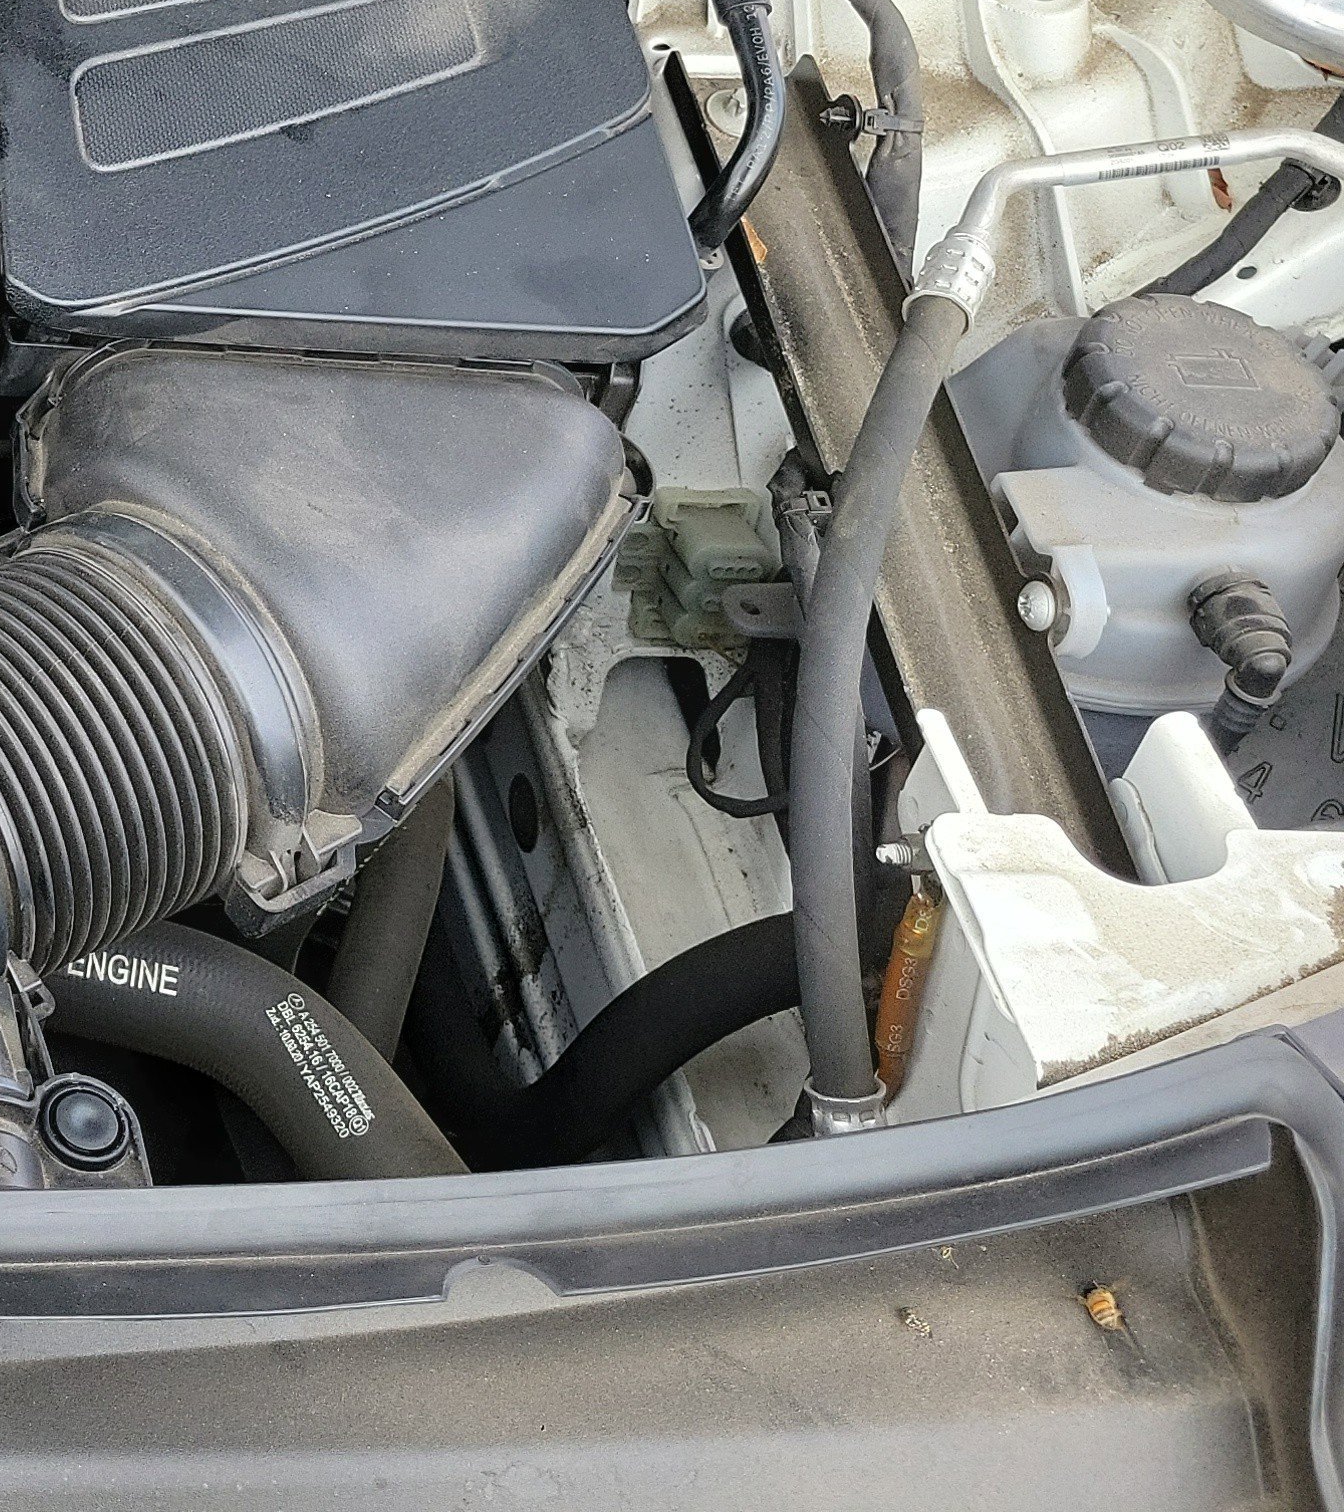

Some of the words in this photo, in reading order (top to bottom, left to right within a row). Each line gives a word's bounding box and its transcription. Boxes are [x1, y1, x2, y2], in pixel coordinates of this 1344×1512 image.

[67, 951, 180, 997] ENGINE
[887, 1024, 904, 1053] SG3
[896, 957, 918, 1001] DSG3
[277, 1000, 296, 1026] DBL
[291, 1023, 323, 1066] 6254.16
[322, 1070, 358, 1119] 16CAP18
[298, 1011, 310, 1020] A
[304, 1018, 321, 1035] 254
[315, 1034, 332, 1052] 501
[325, 1049, 346, 1073] 7000
